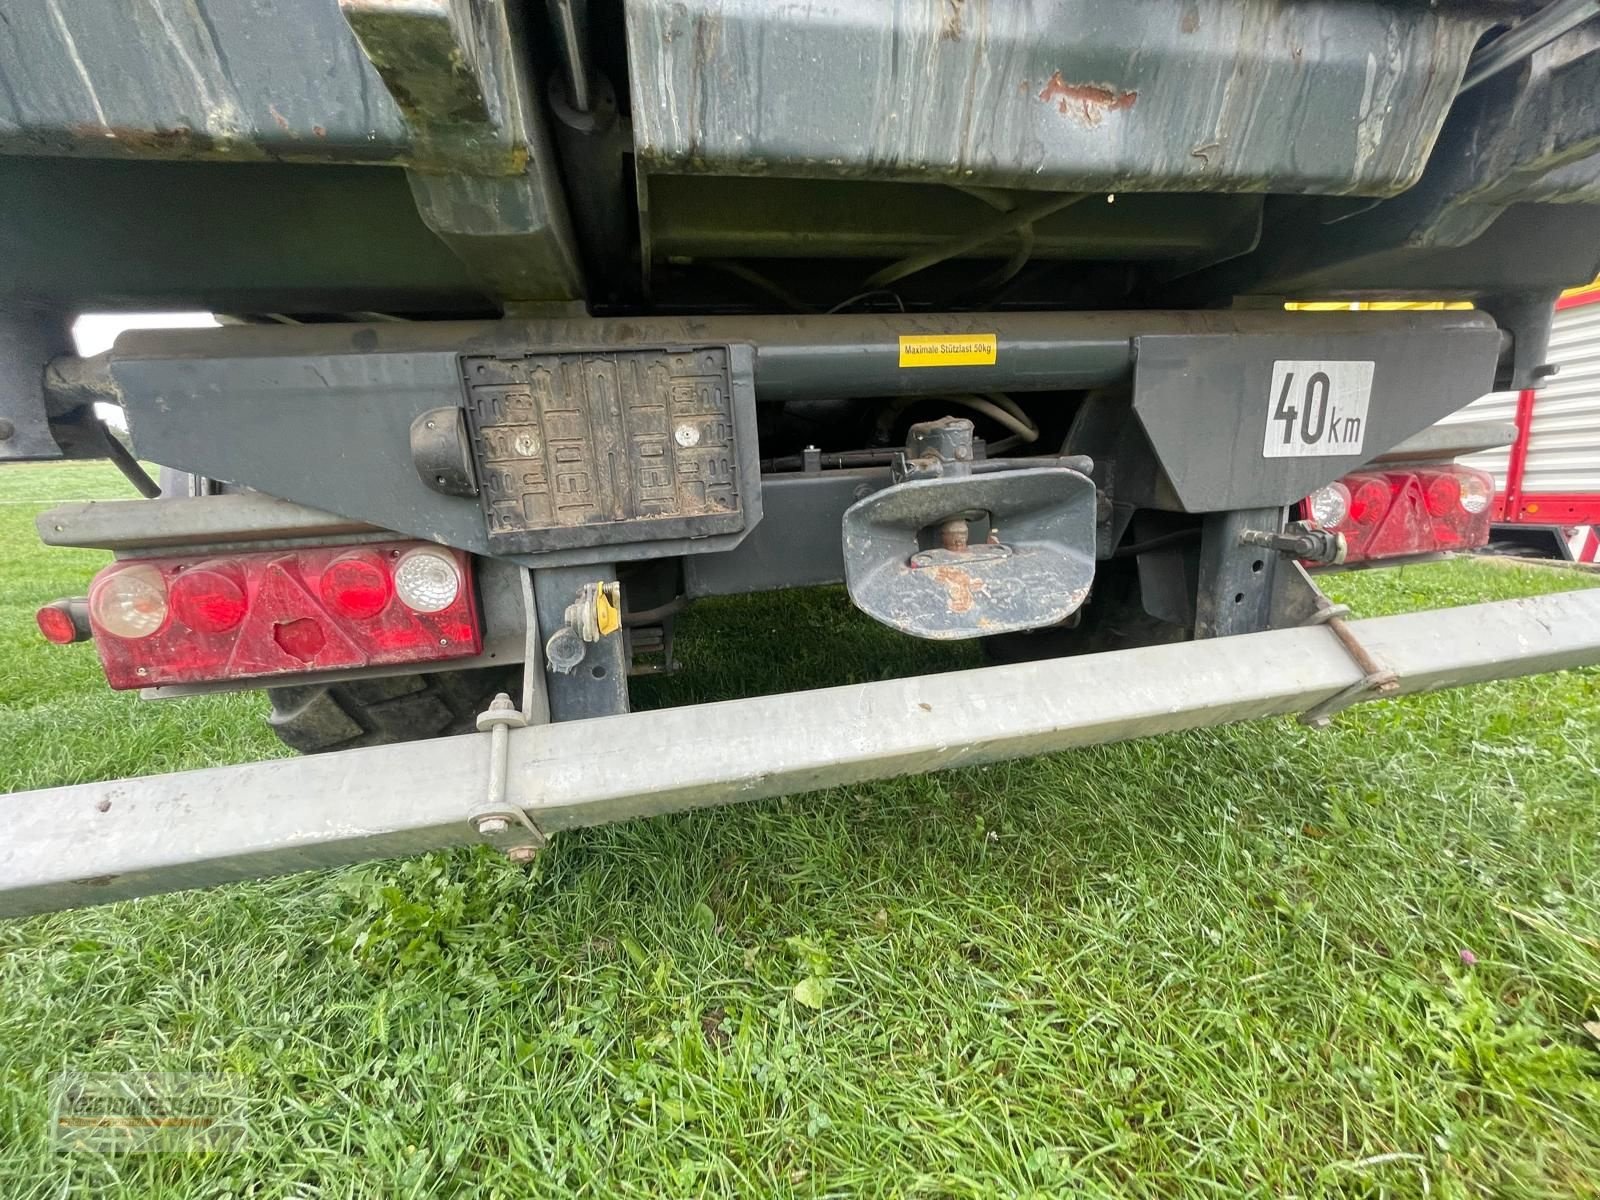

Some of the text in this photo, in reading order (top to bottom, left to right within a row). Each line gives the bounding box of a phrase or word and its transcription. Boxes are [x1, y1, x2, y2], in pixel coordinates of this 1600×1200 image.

[905, 343, 992, 354] Maximale Stützlast 50kg
[1273, 371, 1361, 444] 40 km
